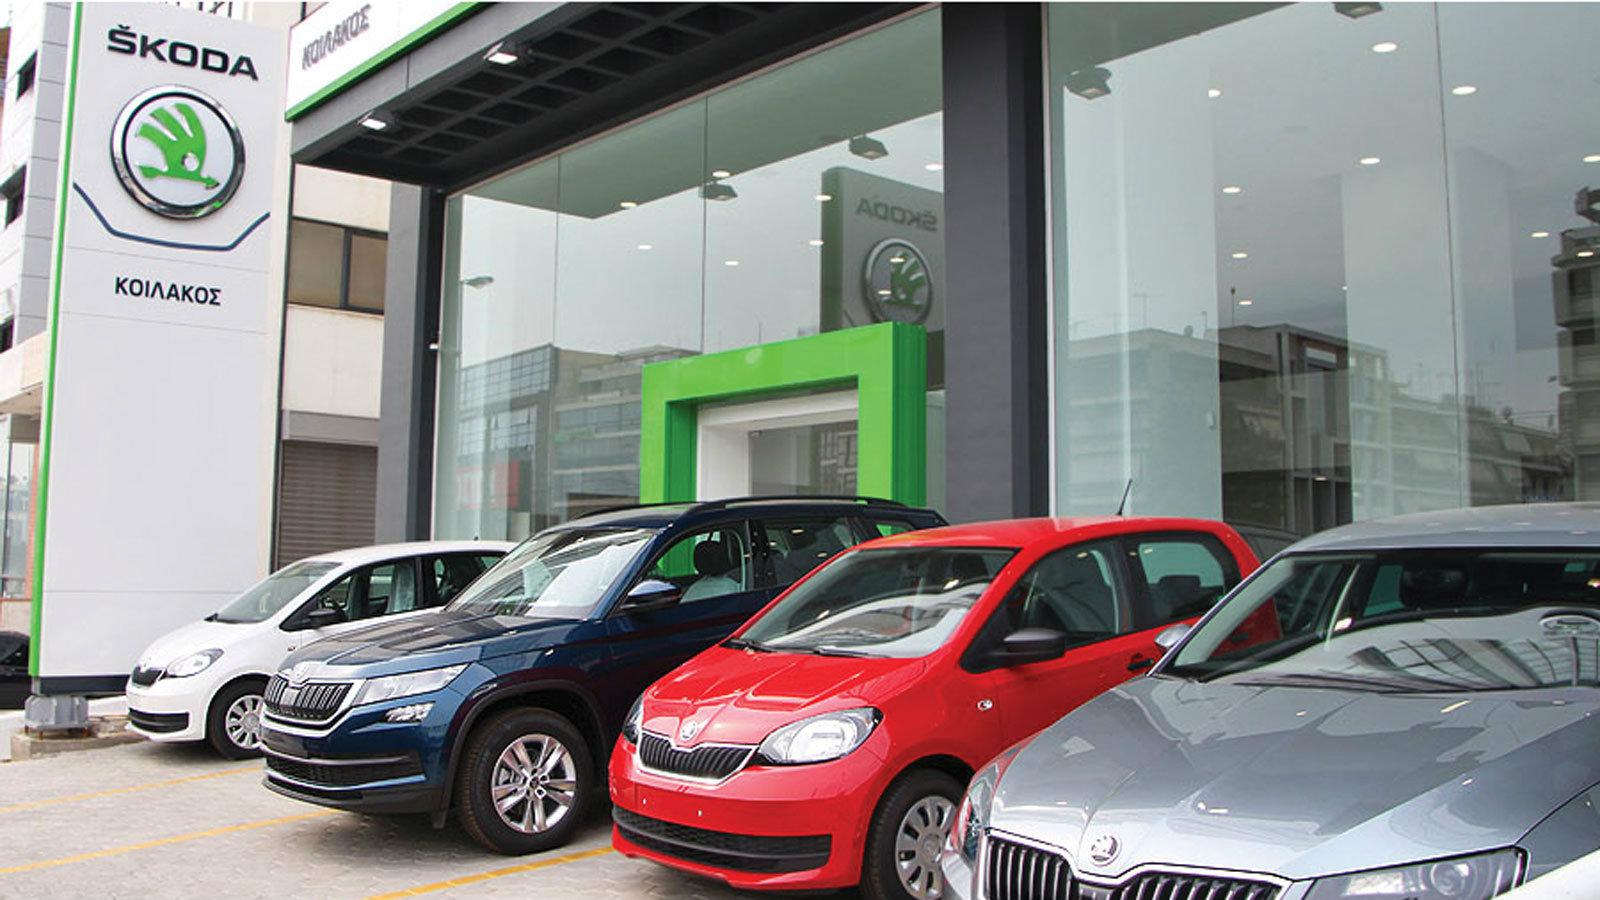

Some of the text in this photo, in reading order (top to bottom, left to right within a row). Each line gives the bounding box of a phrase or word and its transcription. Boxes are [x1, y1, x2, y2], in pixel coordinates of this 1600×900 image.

[107, 24, 259, 81] ŠKODA
[302, 3, 371, 70] ΚΟΙΛΑΚΟΣ
[115, 277, 221, 306] ΚΟΙΛΑΚΟΣ
